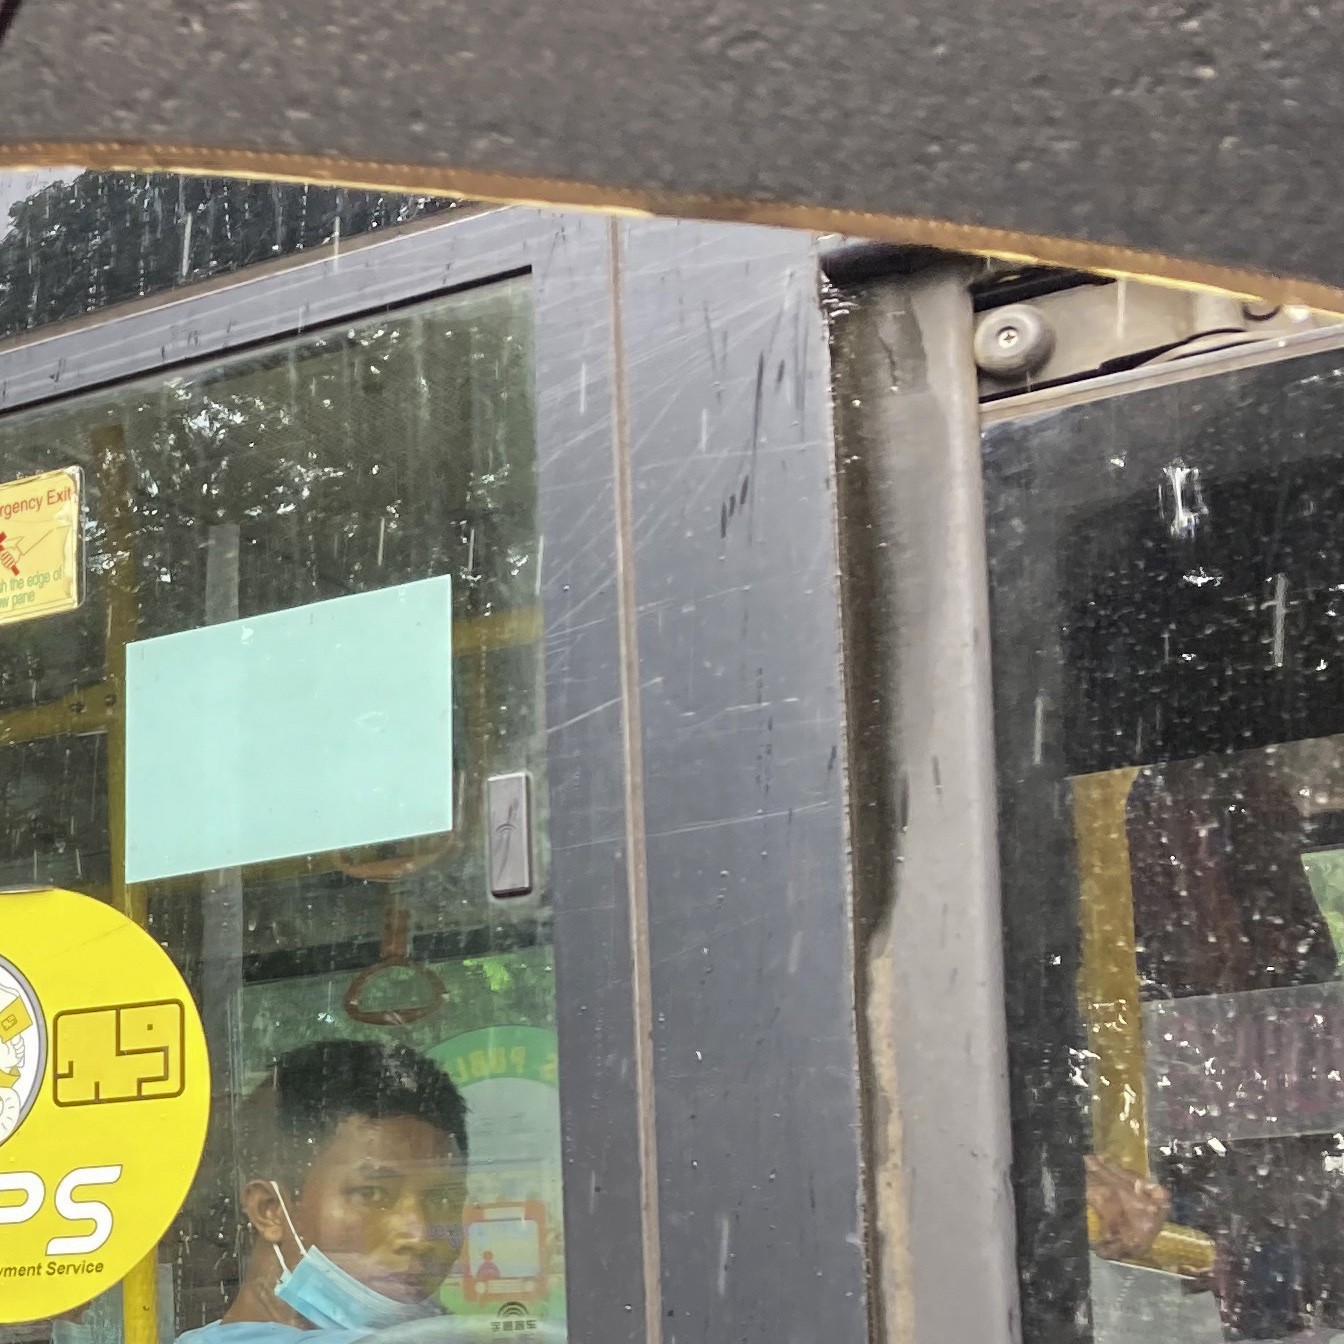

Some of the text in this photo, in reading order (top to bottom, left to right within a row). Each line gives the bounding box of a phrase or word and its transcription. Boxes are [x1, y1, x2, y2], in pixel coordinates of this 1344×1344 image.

[46, 487, 73, 505] Exit
[9, 576, 25, 591] the
[26, 571, 51, 589] edge
[11, 590, 36, 611] pane
[46, 1259, 104, 1276] Service
